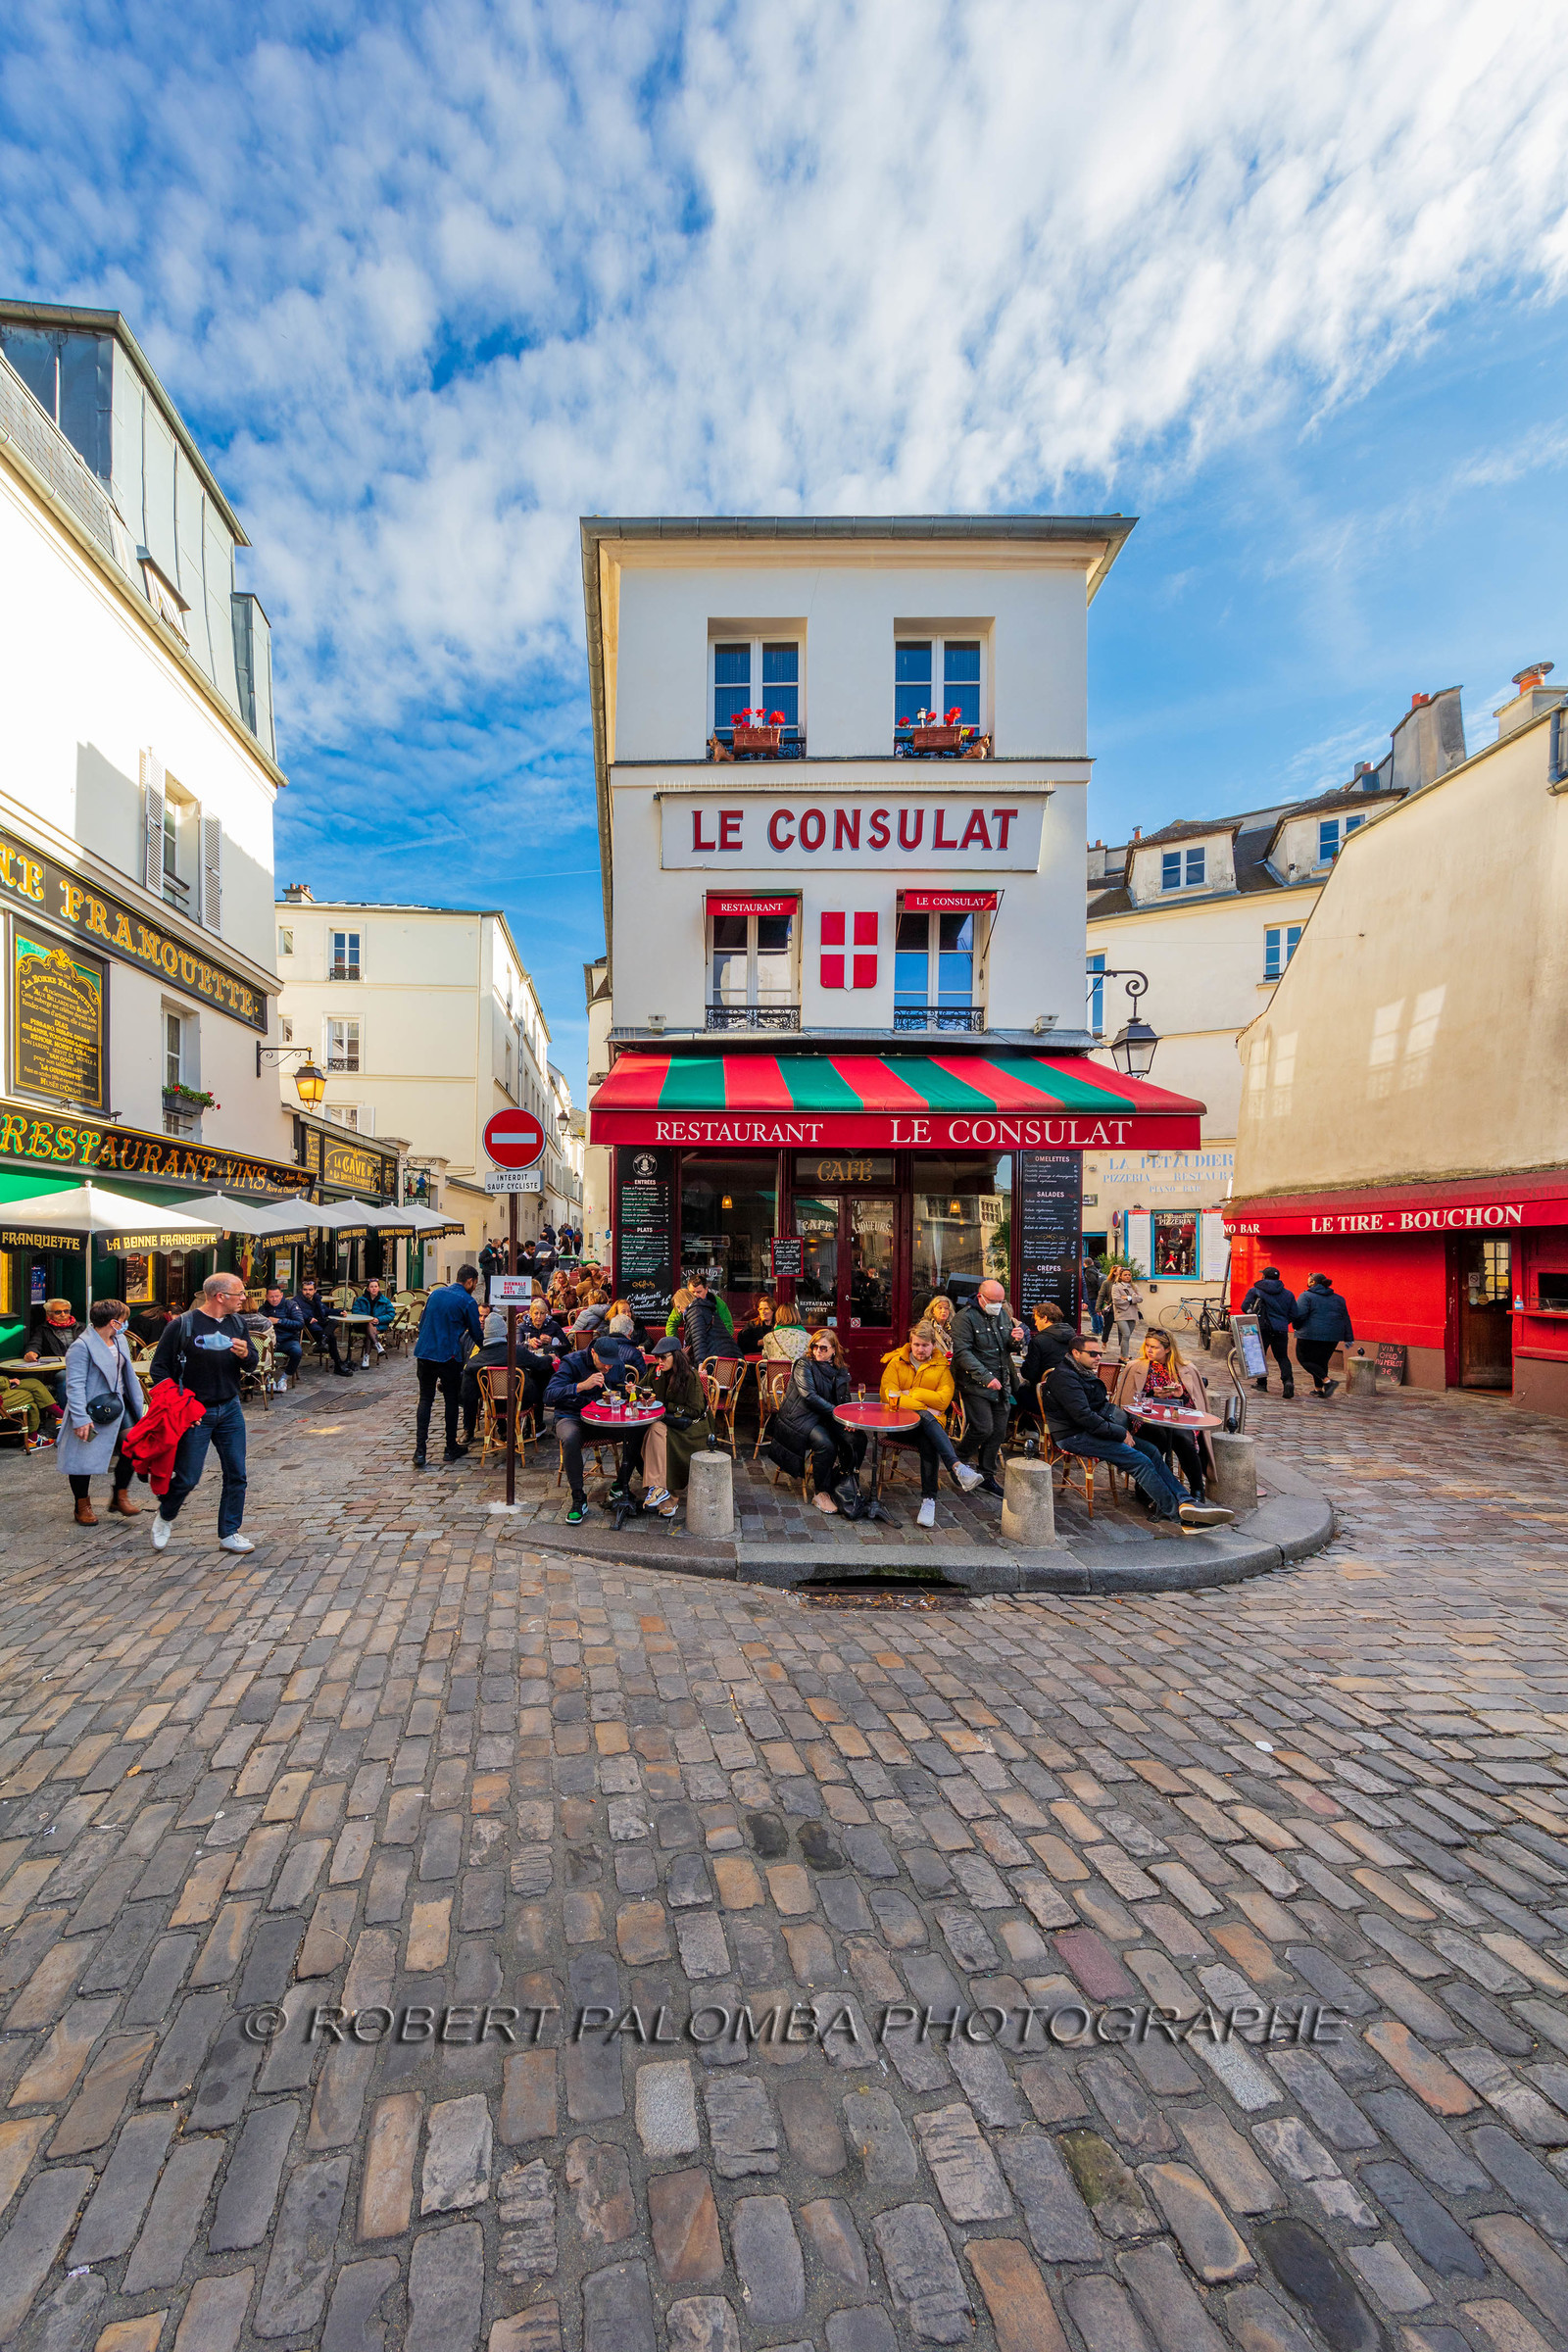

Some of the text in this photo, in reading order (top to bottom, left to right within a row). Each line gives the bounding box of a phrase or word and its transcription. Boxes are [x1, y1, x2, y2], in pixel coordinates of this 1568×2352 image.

[691, 808, 1018, 853] LE CONSULAT
[720, 902, 784, 913] RESTAURANT
[916, 897, 986, 907] LE CONSULAT
[60, 879, 253, 1017] FRANQUETTE
[655, 1121, 824, 1142] RESTAURANT
[890, 1119, 1132, 1145] LE CONSULAT
[0, 1112, 268, 1191] RESTAURANT VINS
[334, 1155, 341, 1169] LA
[342, 1156, 366, 1177] CAVE
[817, 1158, 873, 1181] CAFÉ
[1110, 1158, 1129, 1170] LA
[1103, 1173, 1150, 1183] PIZZERIA
[853, 1221, 891, 1234] LIQUEURS
[1311, 1217, 1333, 1232] LE
[1338, 1215, 1383, 1232] TIRE
[1400, 1205, 1524, 1230] BOUCHON
[1240, 1224, 1260, 1233] BAR
[1, 1231, 80, 1250] FRANQUETTE
[106, 1233, 218, 1251] LA BONNE FRANQUETTE
[682, 1268, 718, 1277] VIN CHAUD
